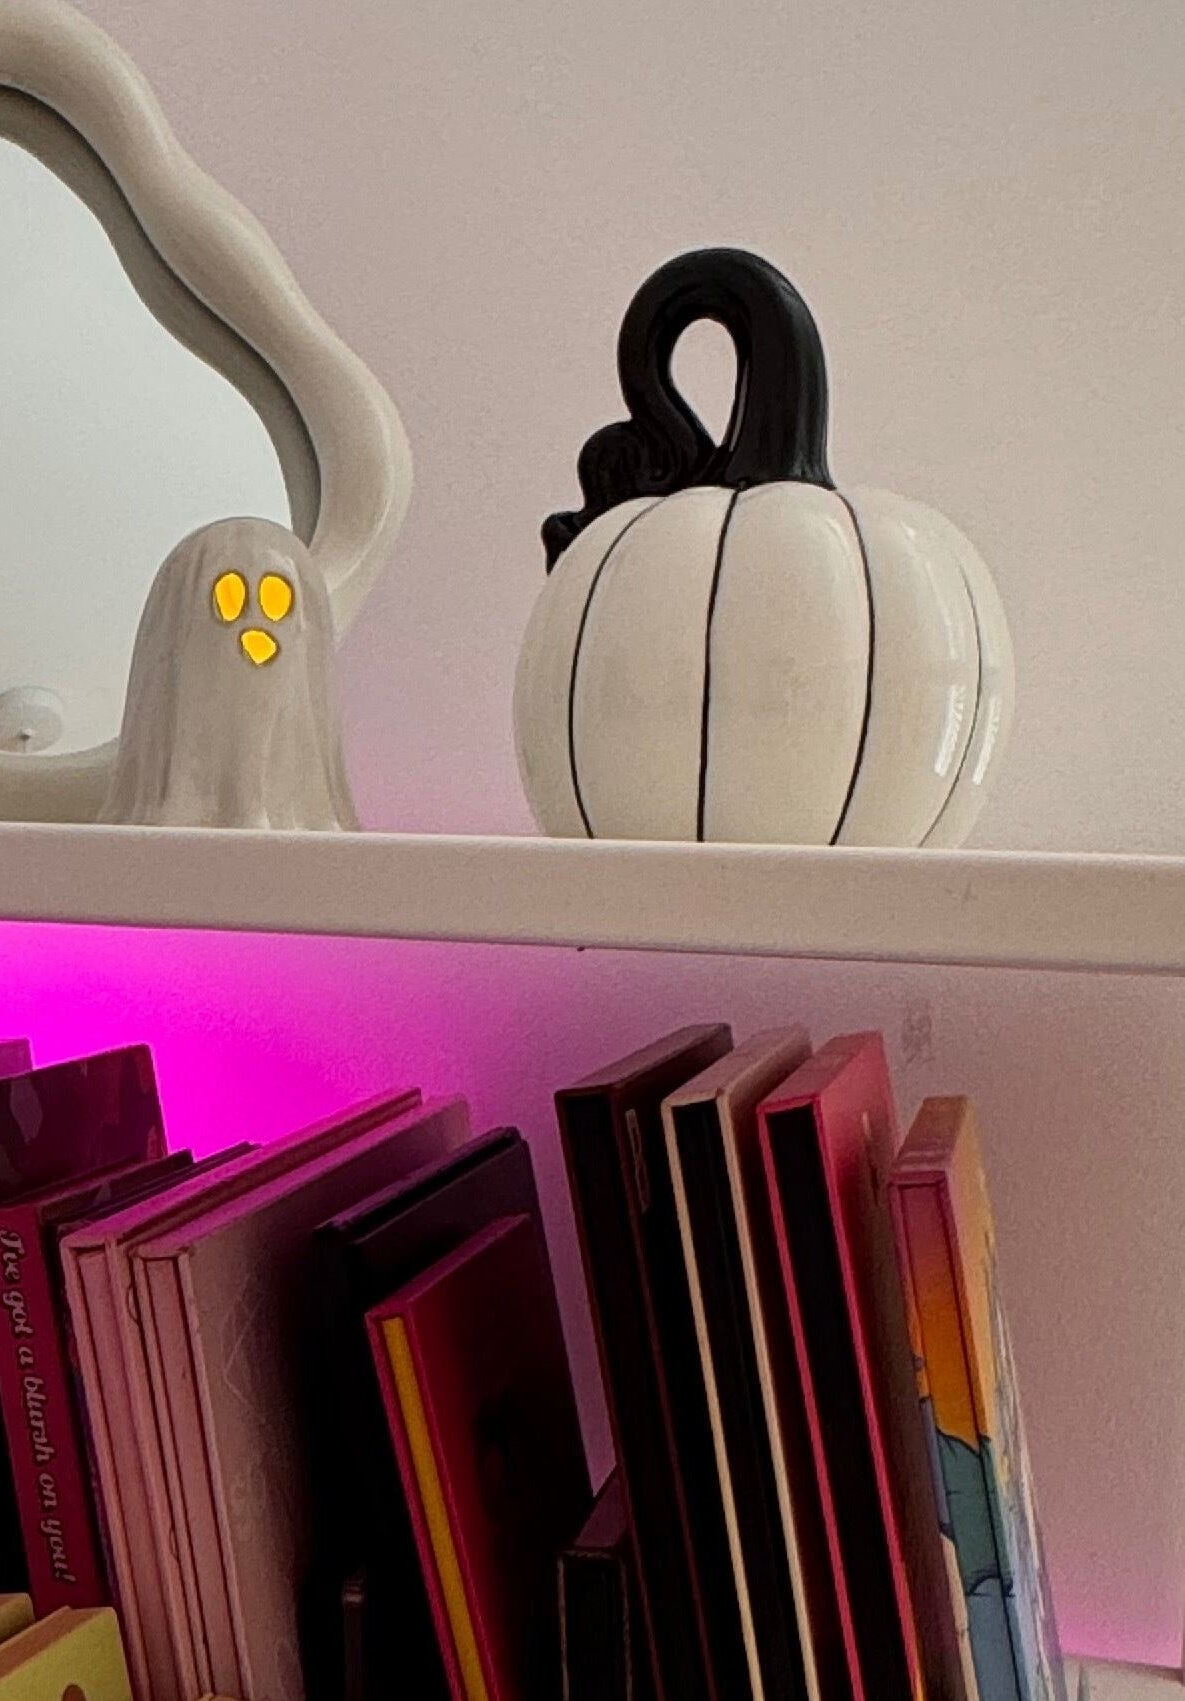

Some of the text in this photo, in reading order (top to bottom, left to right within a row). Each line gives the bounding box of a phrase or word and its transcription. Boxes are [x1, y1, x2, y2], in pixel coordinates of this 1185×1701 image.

[2, 1291, 33, 1334] got
[18, 1346, 34, 1365] a
[39, 1473, 58, 1507] on
[40, 1519, 76, 1582] you!
